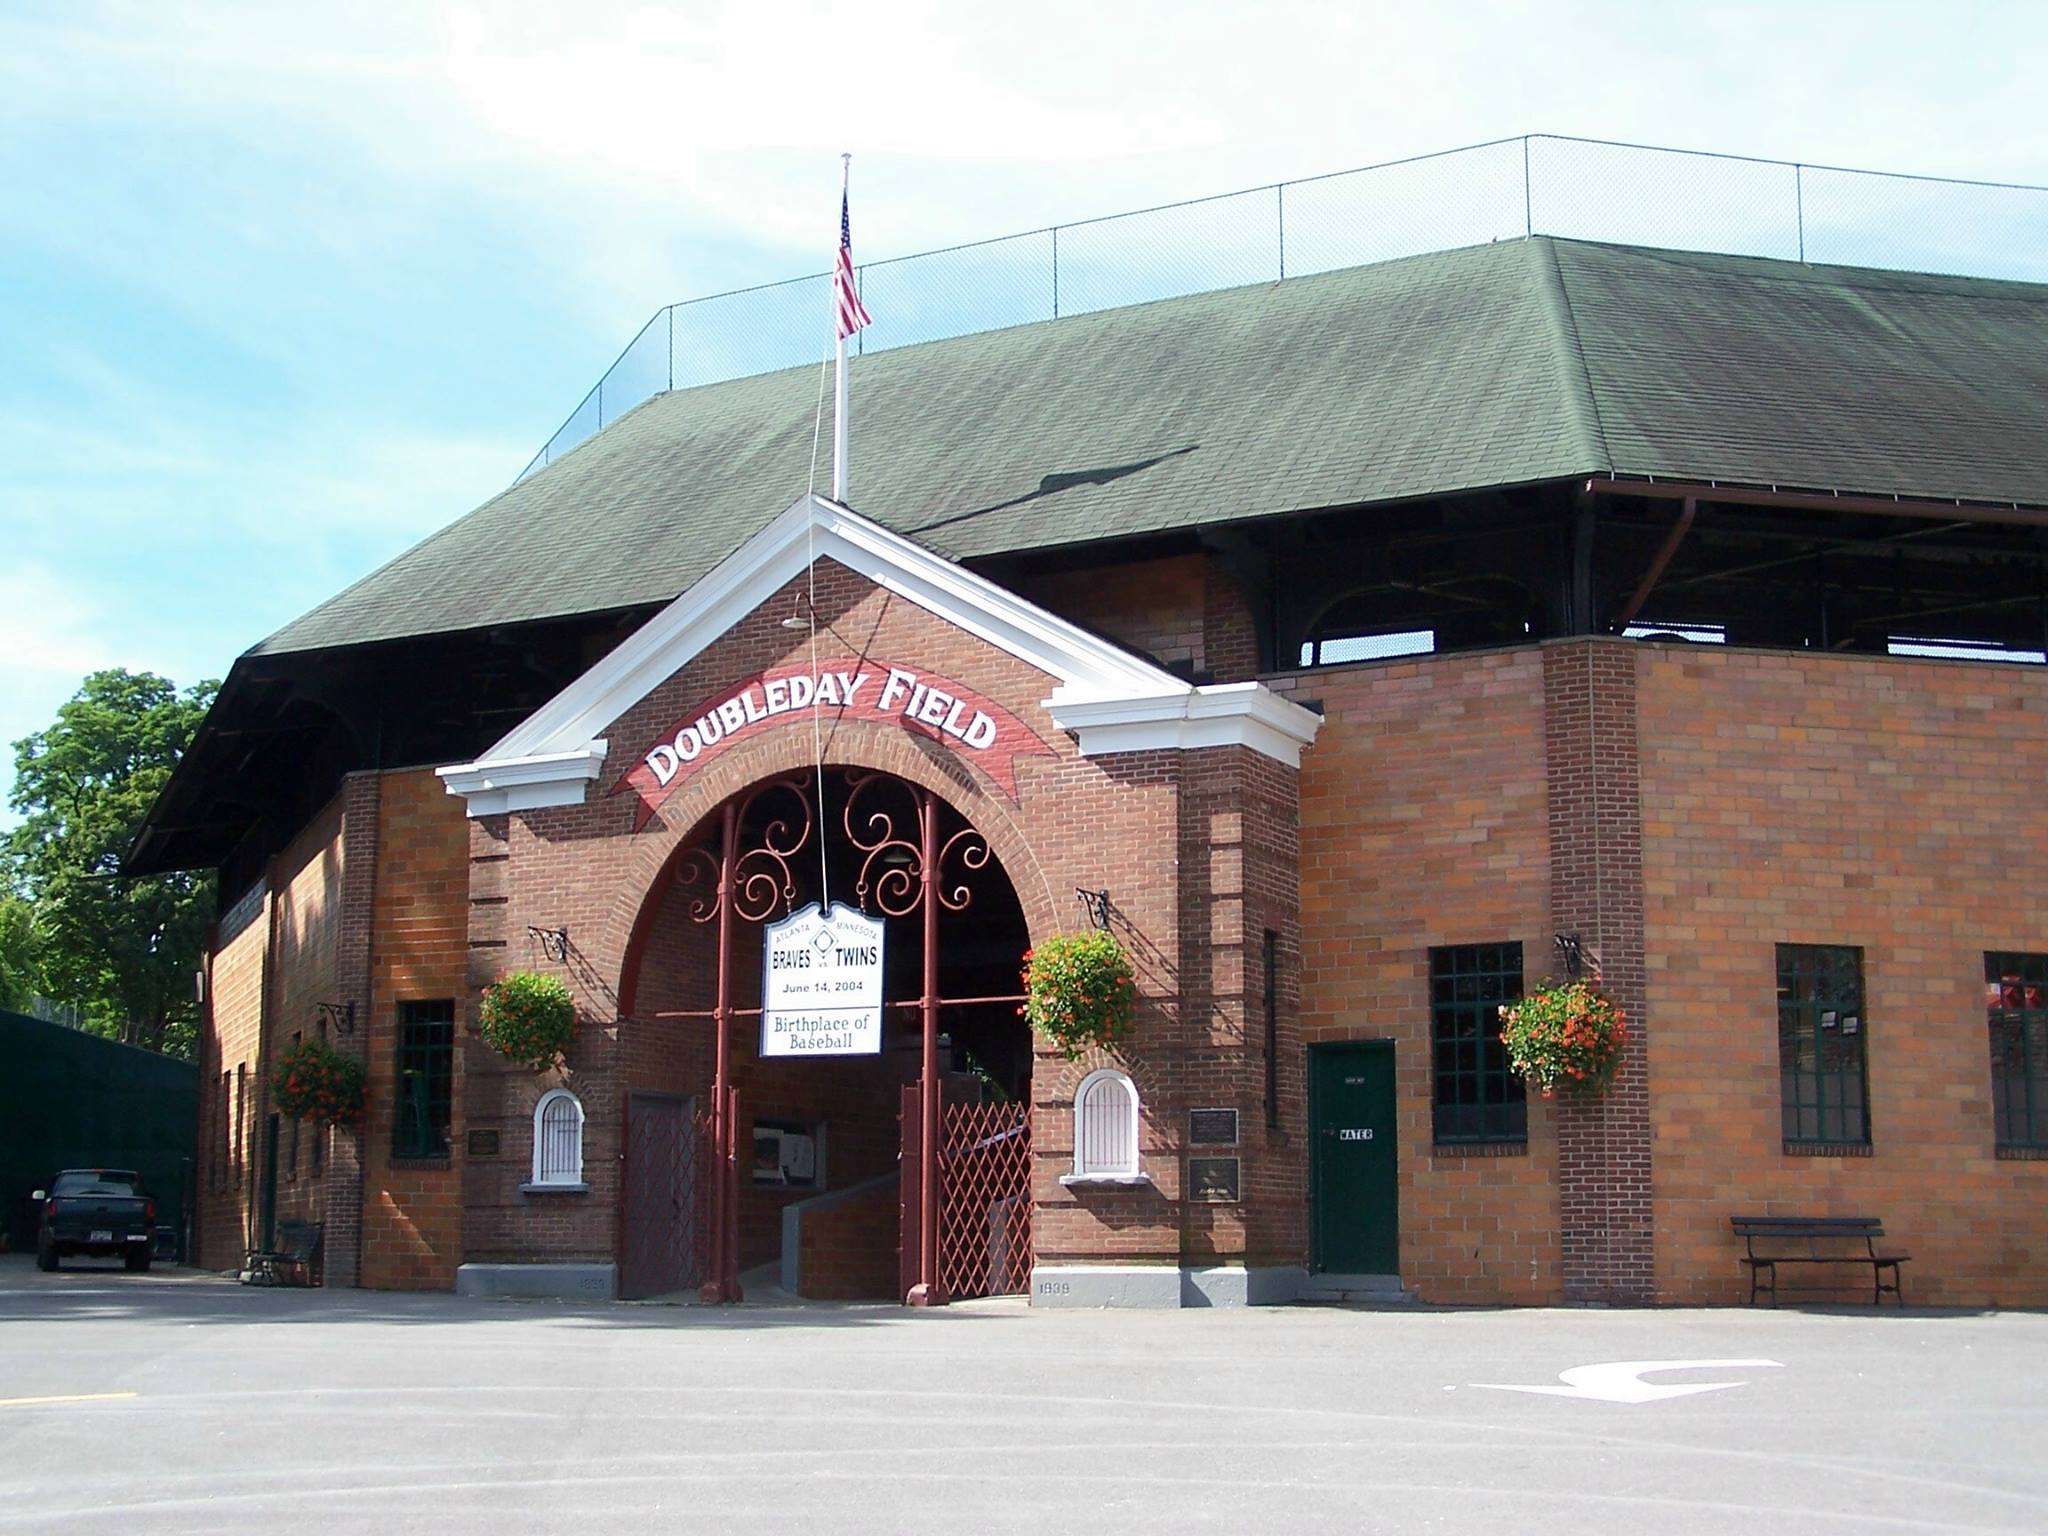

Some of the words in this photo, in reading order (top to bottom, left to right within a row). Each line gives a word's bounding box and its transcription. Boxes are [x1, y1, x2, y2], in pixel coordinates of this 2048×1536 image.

[644, 671, 869, 788] DOUBLEDAY
[878, 667, 998, 750] FIELD
[775, 924, 811, 943] ATLANTA
[836, 921, 878, 940] MINNESOTA
[773, 949, 811, 969] BRAVES
[835, 946, 878, 967] TWINS
[782, 983, 810, 994] June
[814, 983, 831, 993] 14,
[835, 981, 863, 992] 2004
[774, 1015, 849, 1037] Birthplace
[855, 1014, 870, 1030] of
[790, 1032, 853, 1050] Baseball
[1340, 1128, 1373, 1140] WATER
